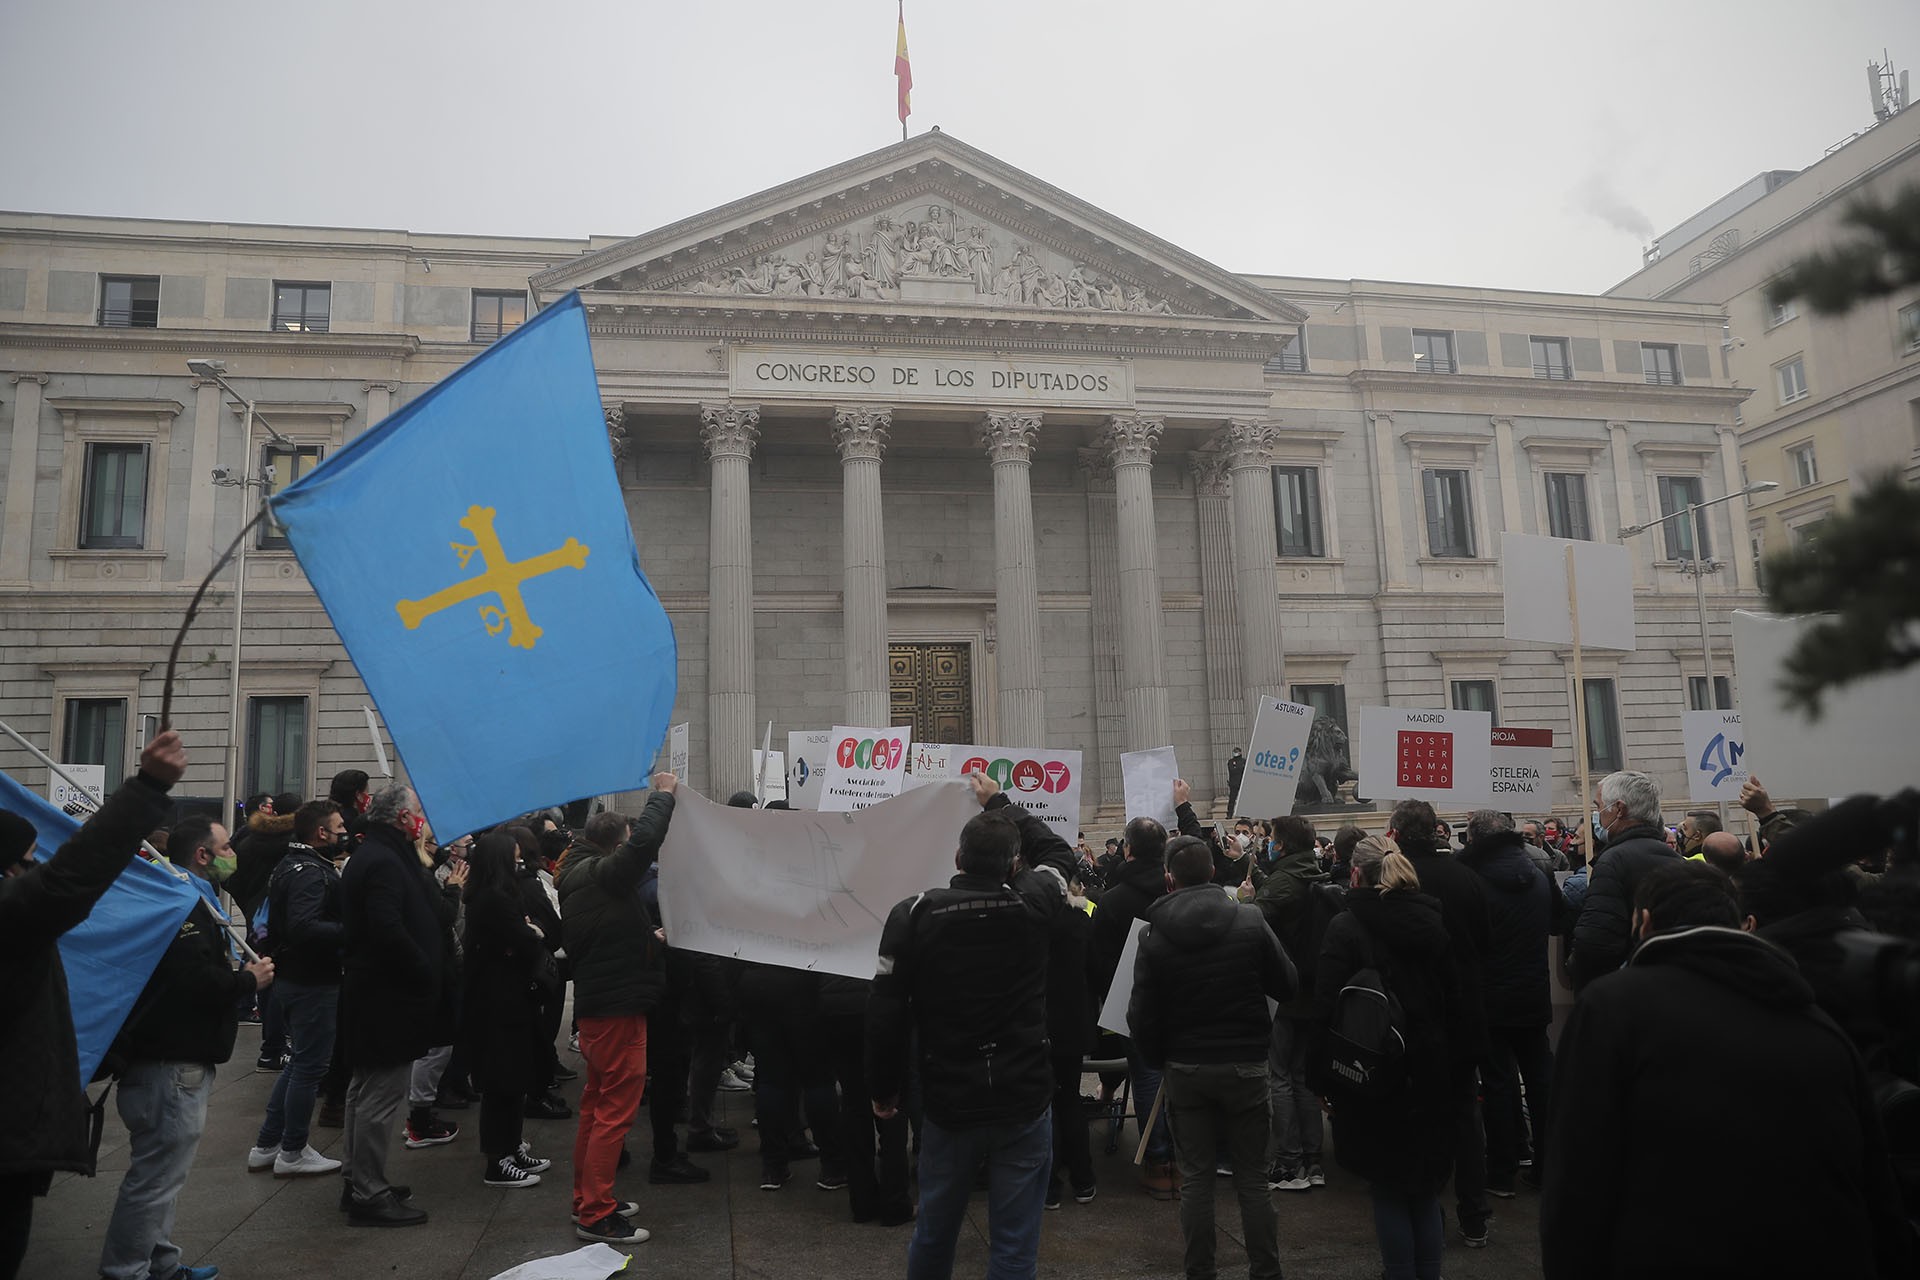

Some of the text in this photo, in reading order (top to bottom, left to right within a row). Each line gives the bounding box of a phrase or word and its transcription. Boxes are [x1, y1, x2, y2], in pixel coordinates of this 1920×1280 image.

[756, 363, 1108, 391] CONGRESO DE LOS DIPUTADOS
[1275, 703, 1304, 716] ASTURIAS
[1407, 713, 1445, 724] MADRID
[1492, 731, 1516, 741] RIOJA
[1490, 765, 1540, 779] STELERÍA
[1493, 780, 1534, 793] ESPAÑA
[1332, 1059, 1363, 1083] PUMA
